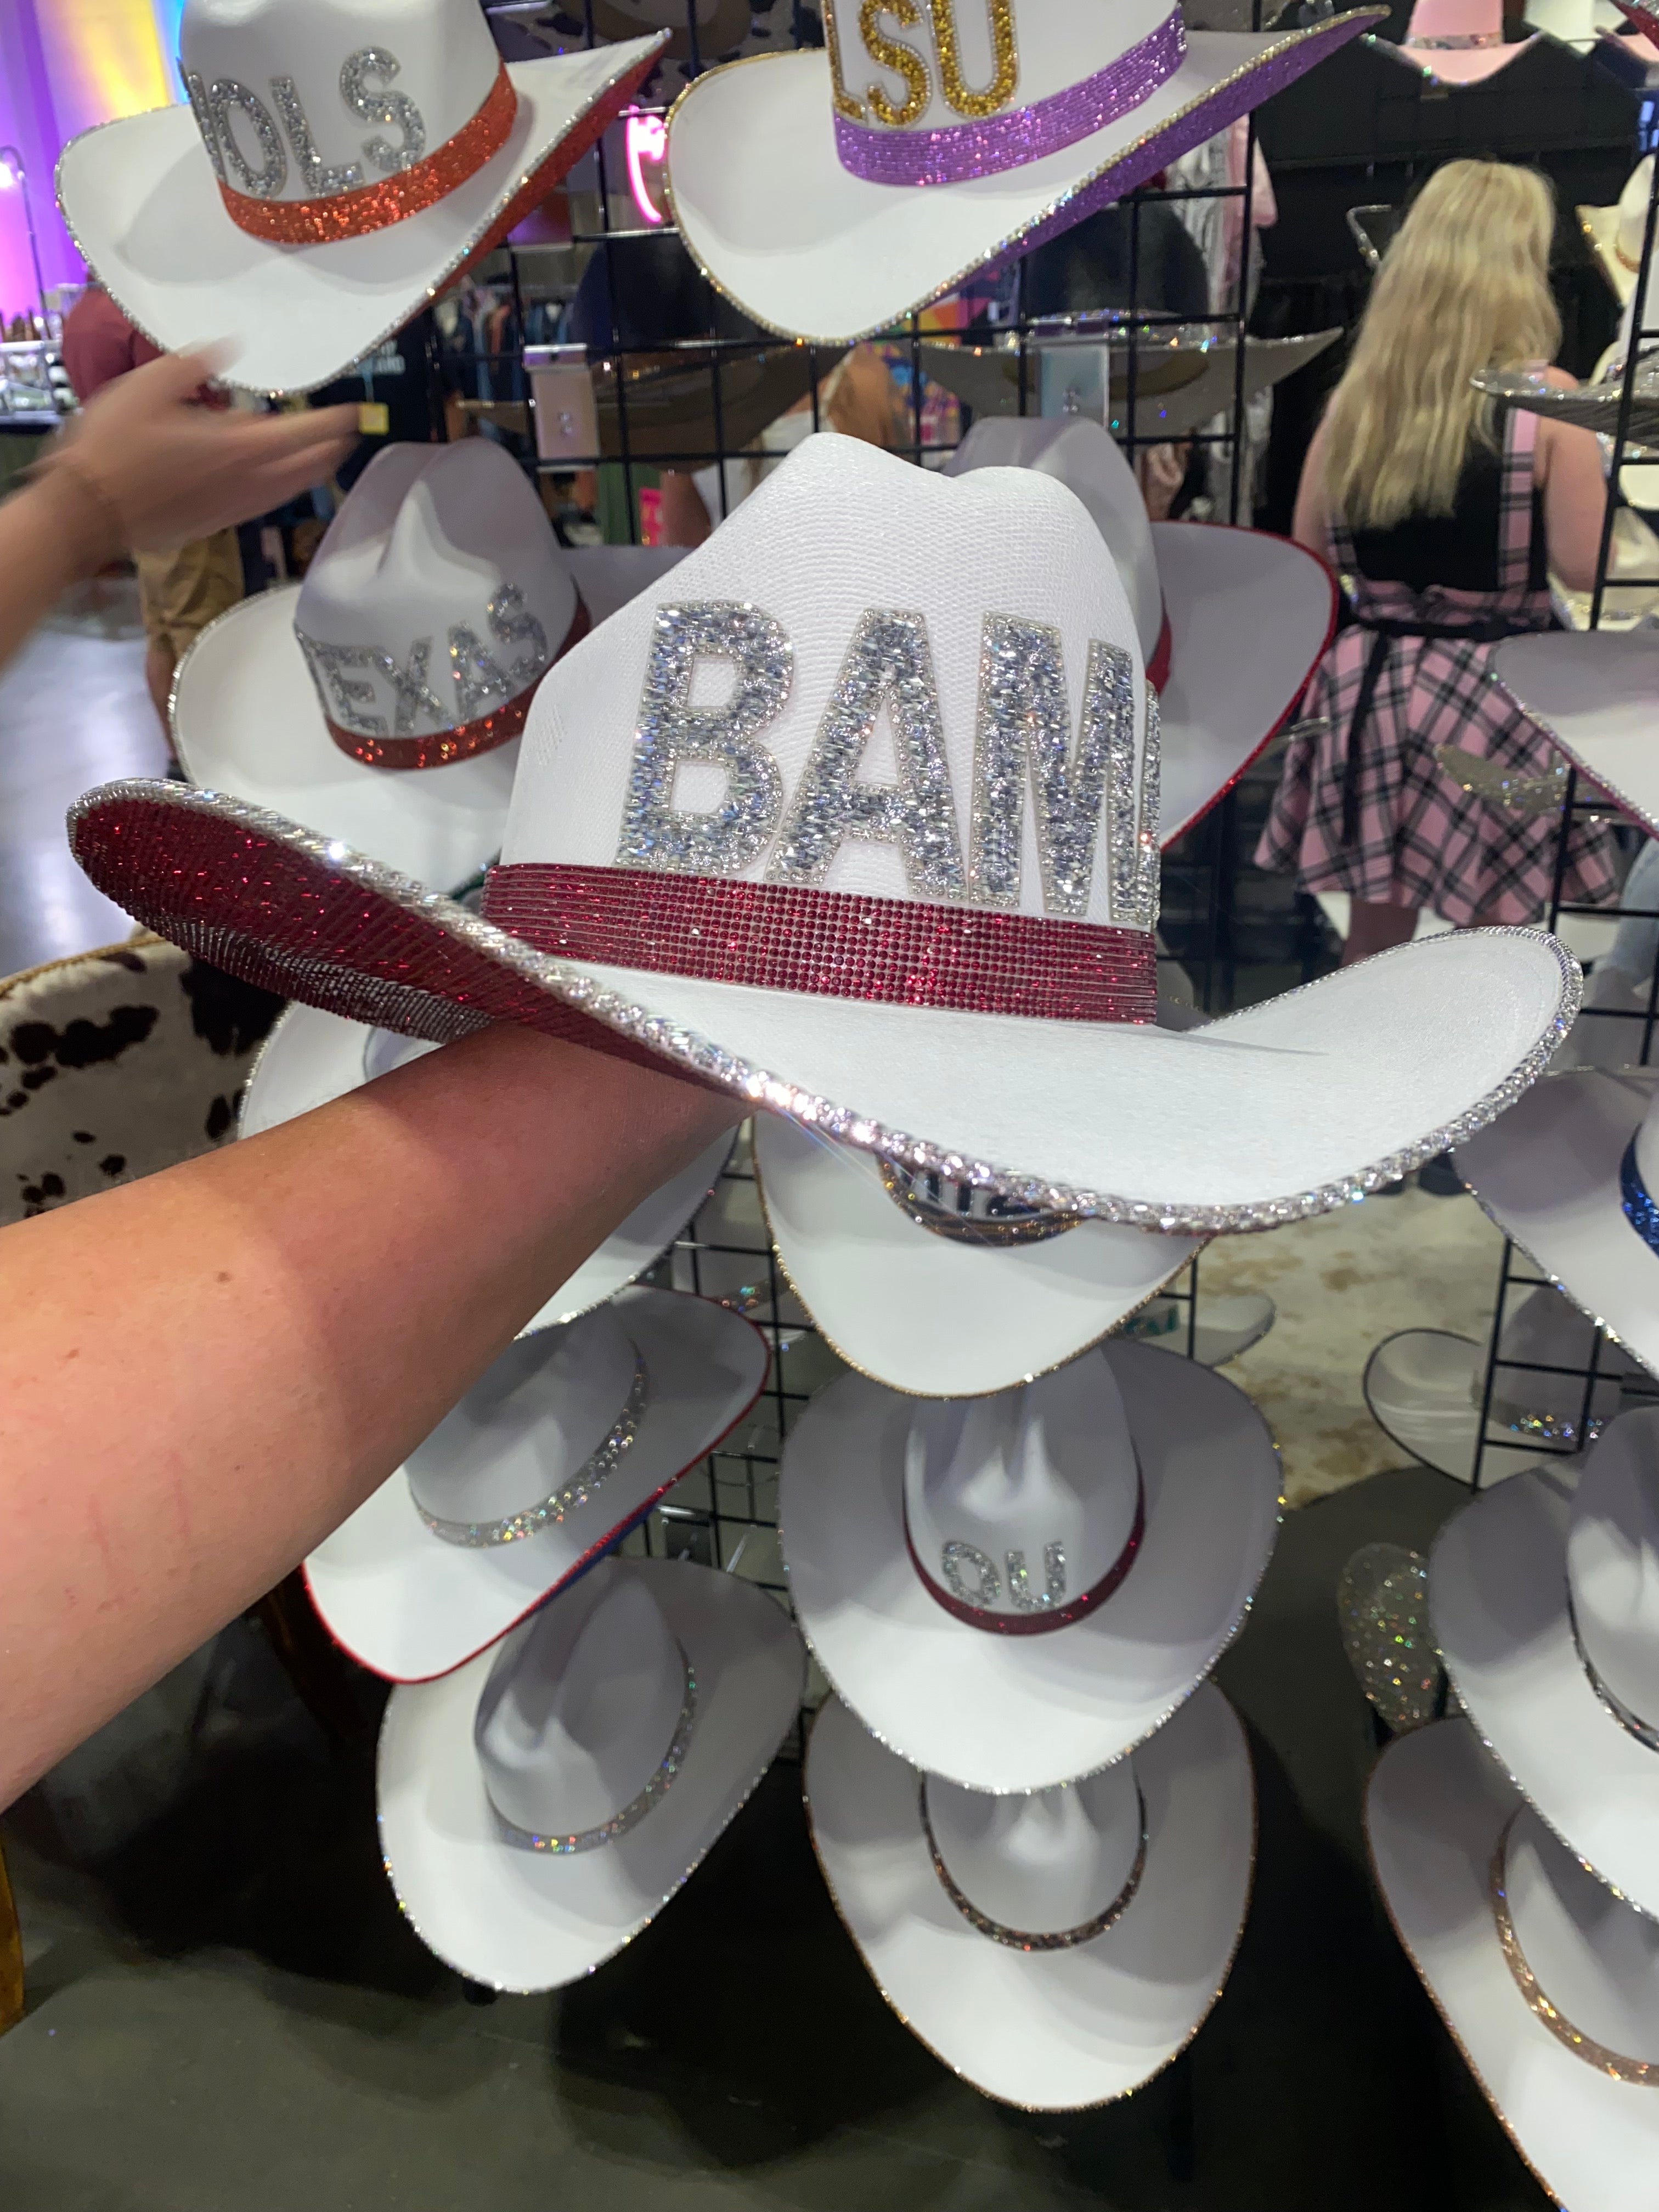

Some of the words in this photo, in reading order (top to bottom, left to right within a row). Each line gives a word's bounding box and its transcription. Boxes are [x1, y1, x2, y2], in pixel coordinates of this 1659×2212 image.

[823, 0, 1020, 132] LSU
[614, 599, 1162, 927] BAM
[941, 1539, 1066, 1613] OU
